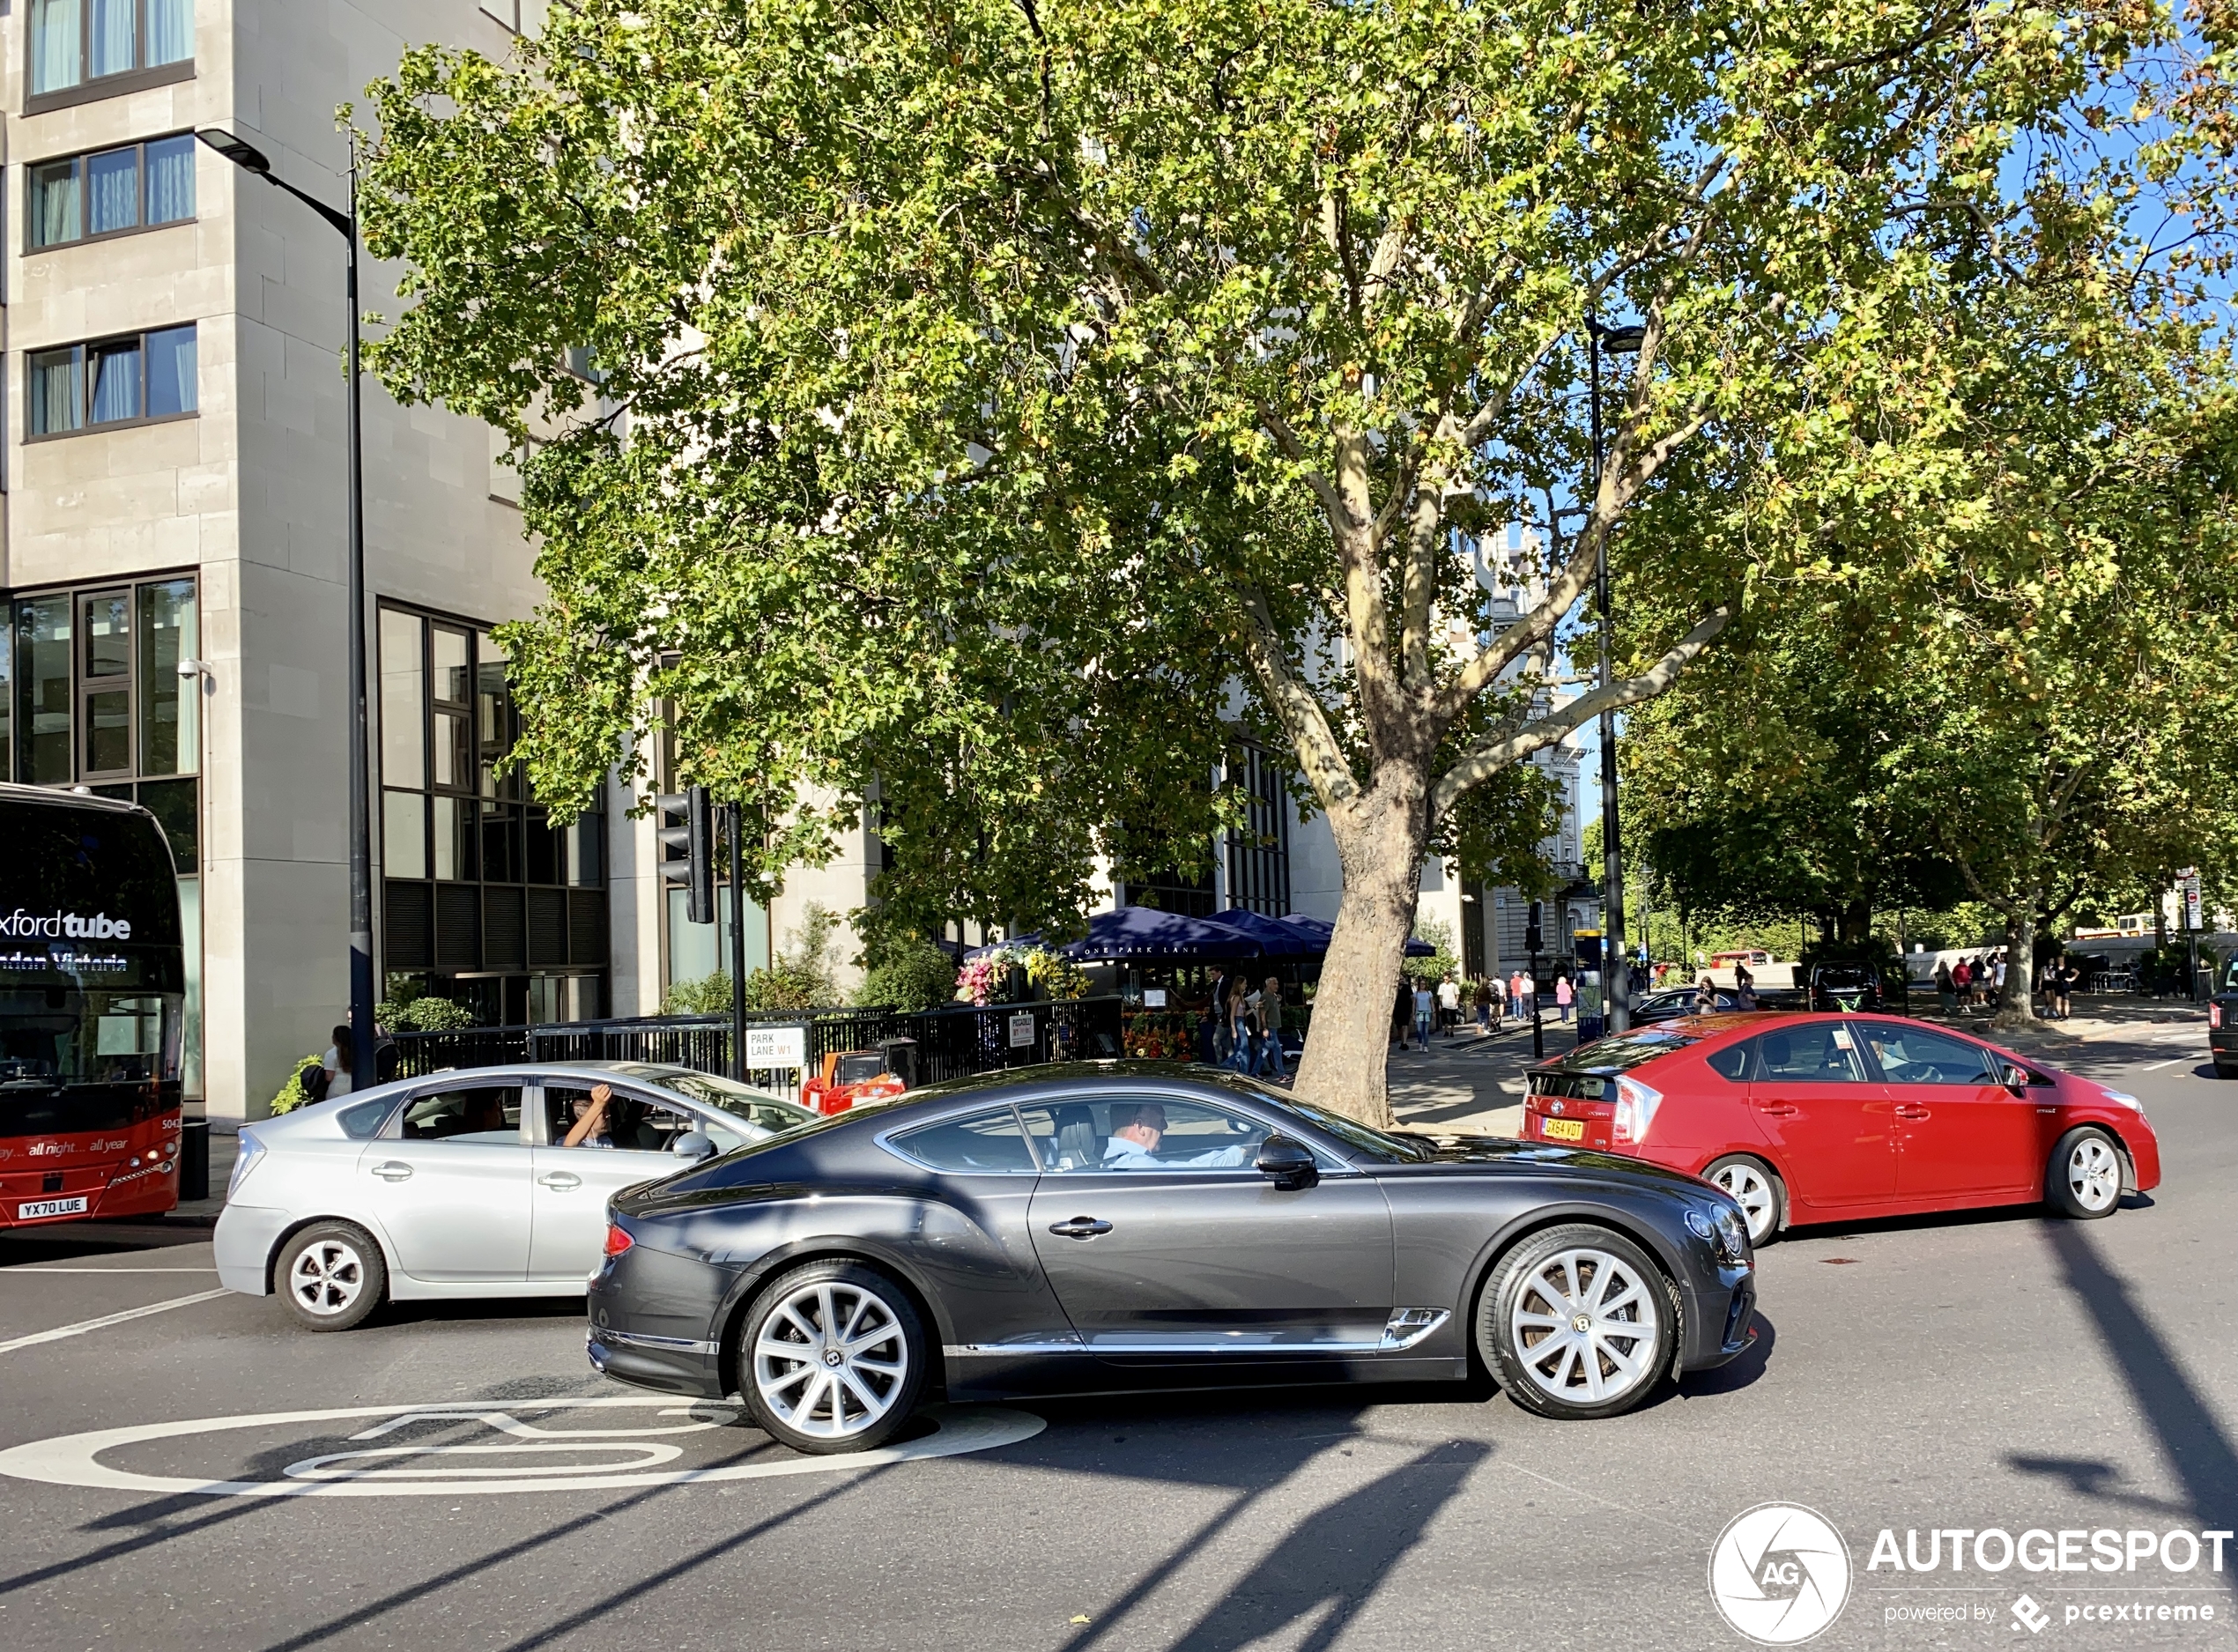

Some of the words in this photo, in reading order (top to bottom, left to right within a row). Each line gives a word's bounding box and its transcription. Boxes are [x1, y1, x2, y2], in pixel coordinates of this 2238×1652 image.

[63, 912, 131, 940] tube
[751, 1033, 774, 1043] PARK
[751, 1045, 774, 1056] LANE
[777, 1045, 791, 1056] W1
[1545, 1120, 1565, 1134] GX64
[1567, 1122, 1582, 1137] VDT
[28, 1143, 44, 1156] all
[89, 1138, 103, 1151] all
[104, 1138, 129, 1153] year
[25, 1202, 56, 1216] YX70
[59, 1199, 81, 1212] LUE
